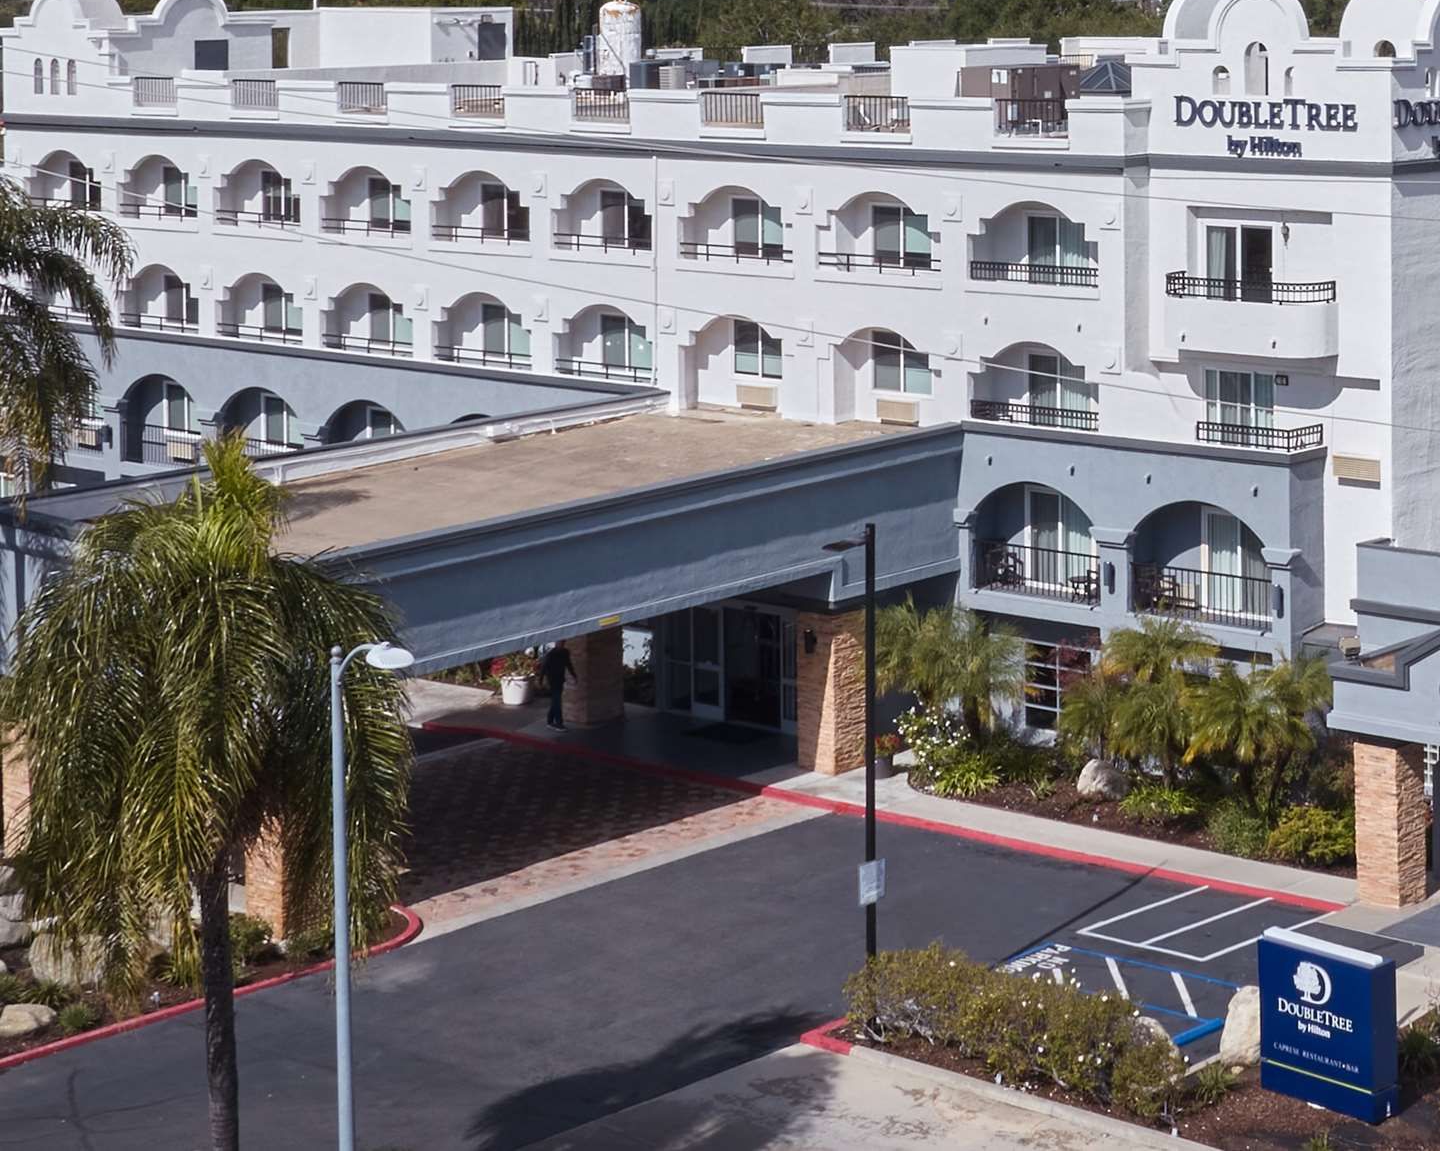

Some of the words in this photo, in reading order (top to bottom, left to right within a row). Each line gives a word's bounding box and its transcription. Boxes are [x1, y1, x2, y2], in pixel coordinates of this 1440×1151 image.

[1173, 95, 1358, 132] DOUBLETREE
[1227, 135, 1248, 158] by
[1249, 136, 1303, 157] Hilton
[1278, 997, 1353, 1033] DOUBLETREE
[1298, 1020, 1307, 1033] by
[1307, 1023, 1331, 1039] Hilton
[1273, 1041, 1300, 1056] CAPRESE
